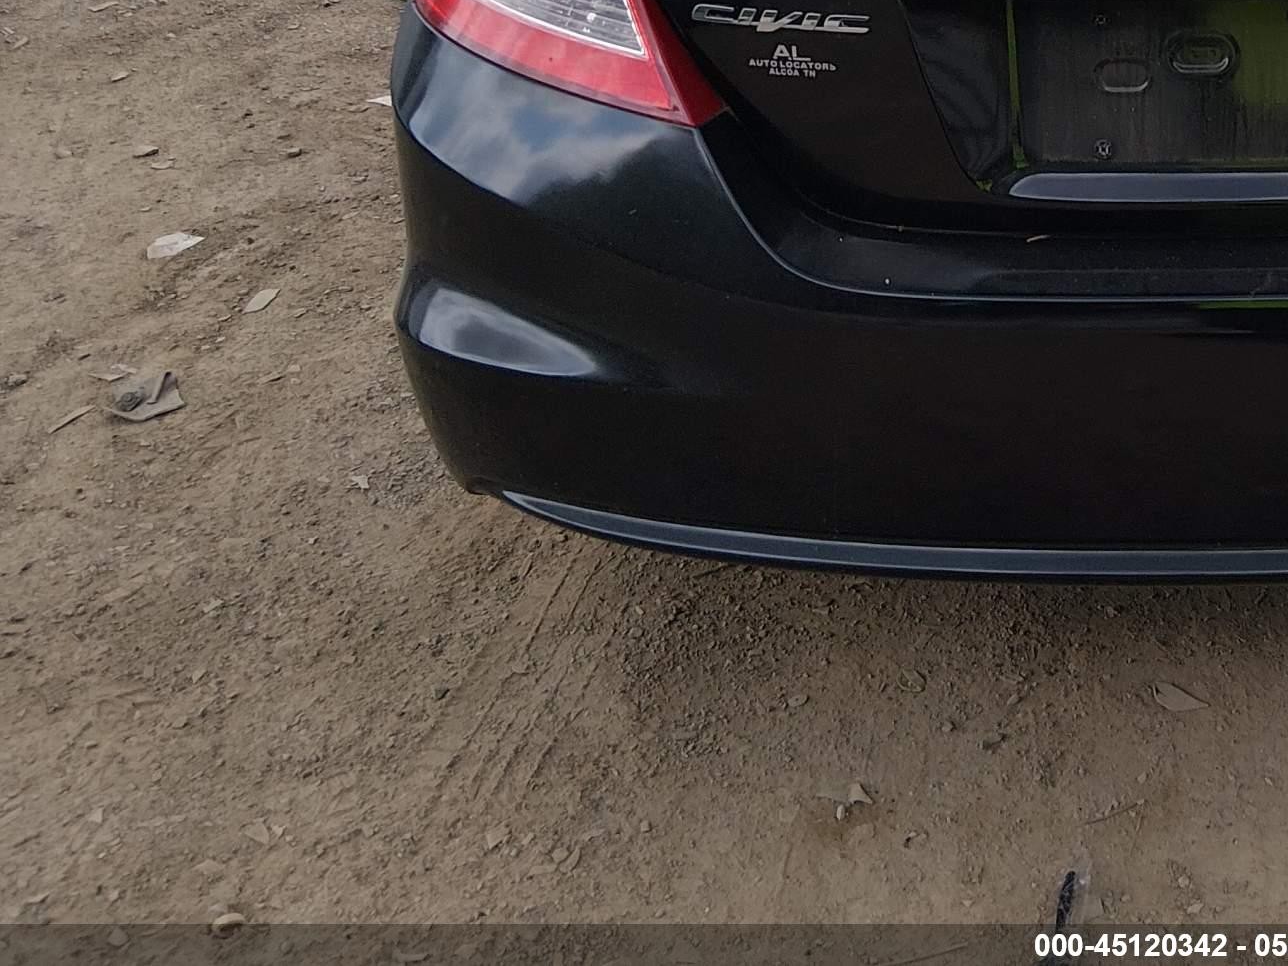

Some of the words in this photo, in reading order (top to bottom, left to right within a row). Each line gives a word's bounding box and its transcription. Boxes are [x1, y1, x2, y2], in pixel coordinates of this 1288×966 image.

[692, 3, 870, 33] CIVIC
[773, 44, 811, 61] AL
[749, 58, 777, 68] AUTO
[769, 68, 800, 77] ALCOA
